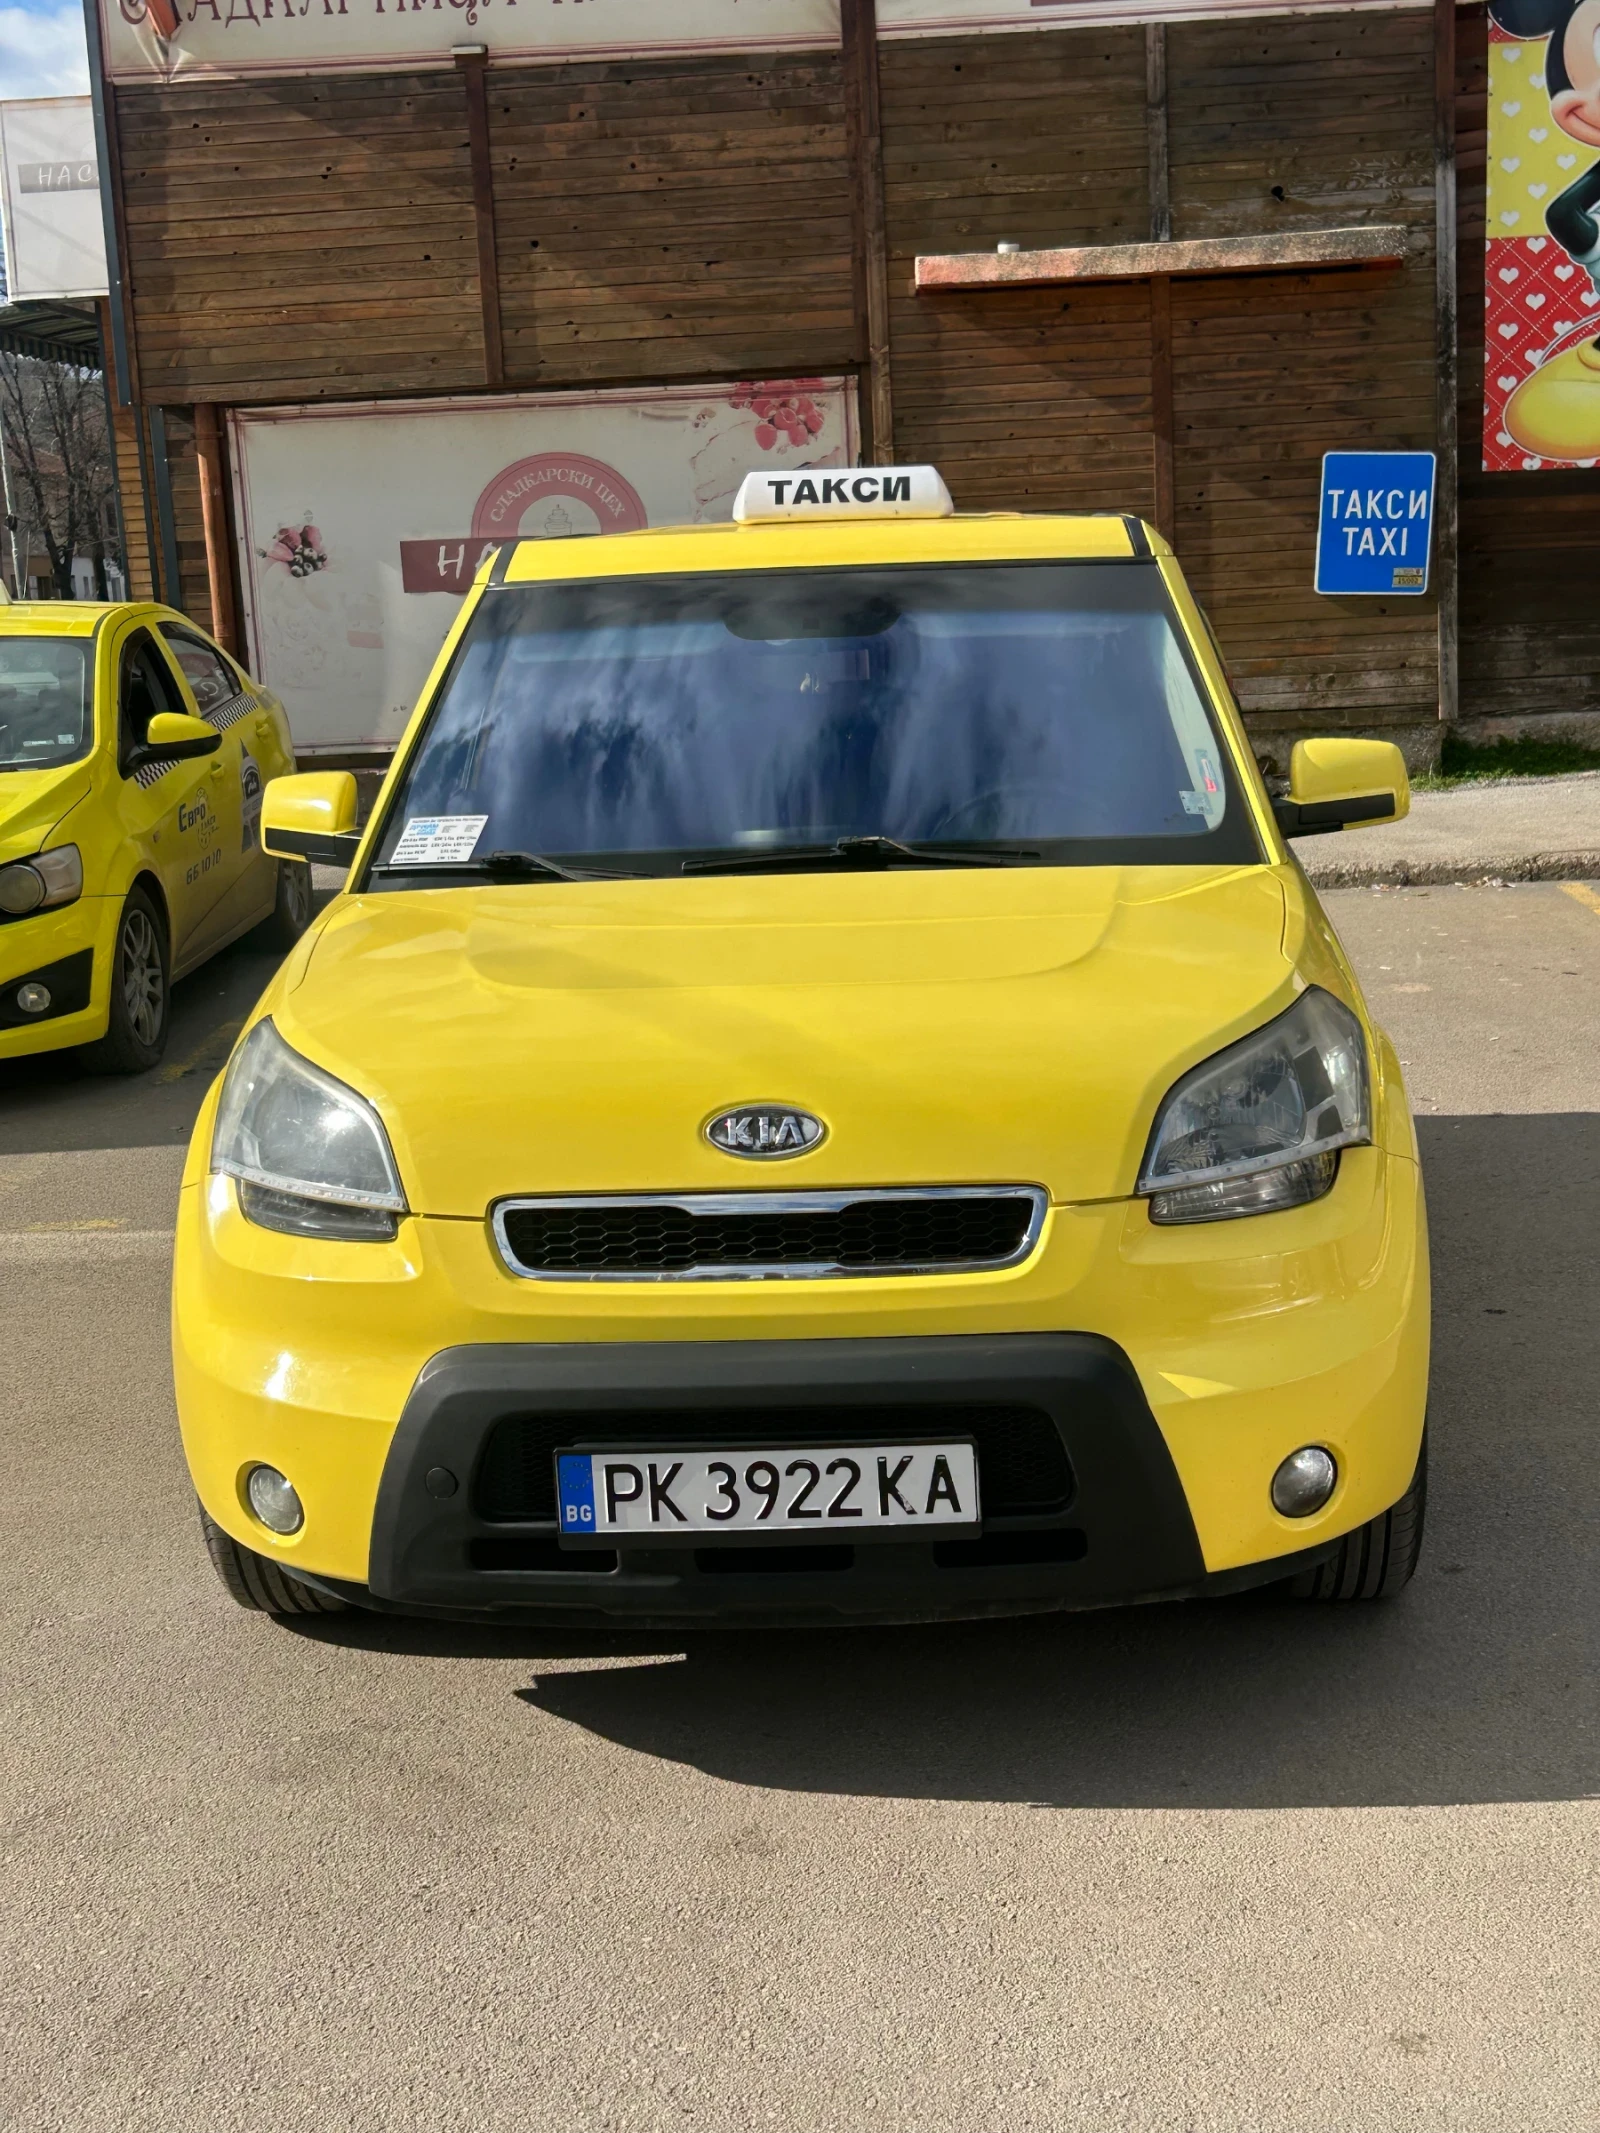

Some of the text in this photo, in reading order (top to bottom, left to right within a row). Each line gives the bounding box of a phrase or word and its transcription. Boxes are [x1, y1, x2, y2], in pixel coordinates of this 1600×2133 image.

[38, 163, 99, 186] НАС
[489, 468, 626, 522] СЛАДКАРСКИ ЦЕХ
[768, 476, 911, 505] ТАКСИ
[1327, 489, 1427, 520] ТАКСИ
[1342, 527, 1408, 556] TAXI
[726, 1115, 804, 1145] KIA
[603, 1455, 962, 1523] PK 3922 KA
[566, 1504, 593, 1522] BG
